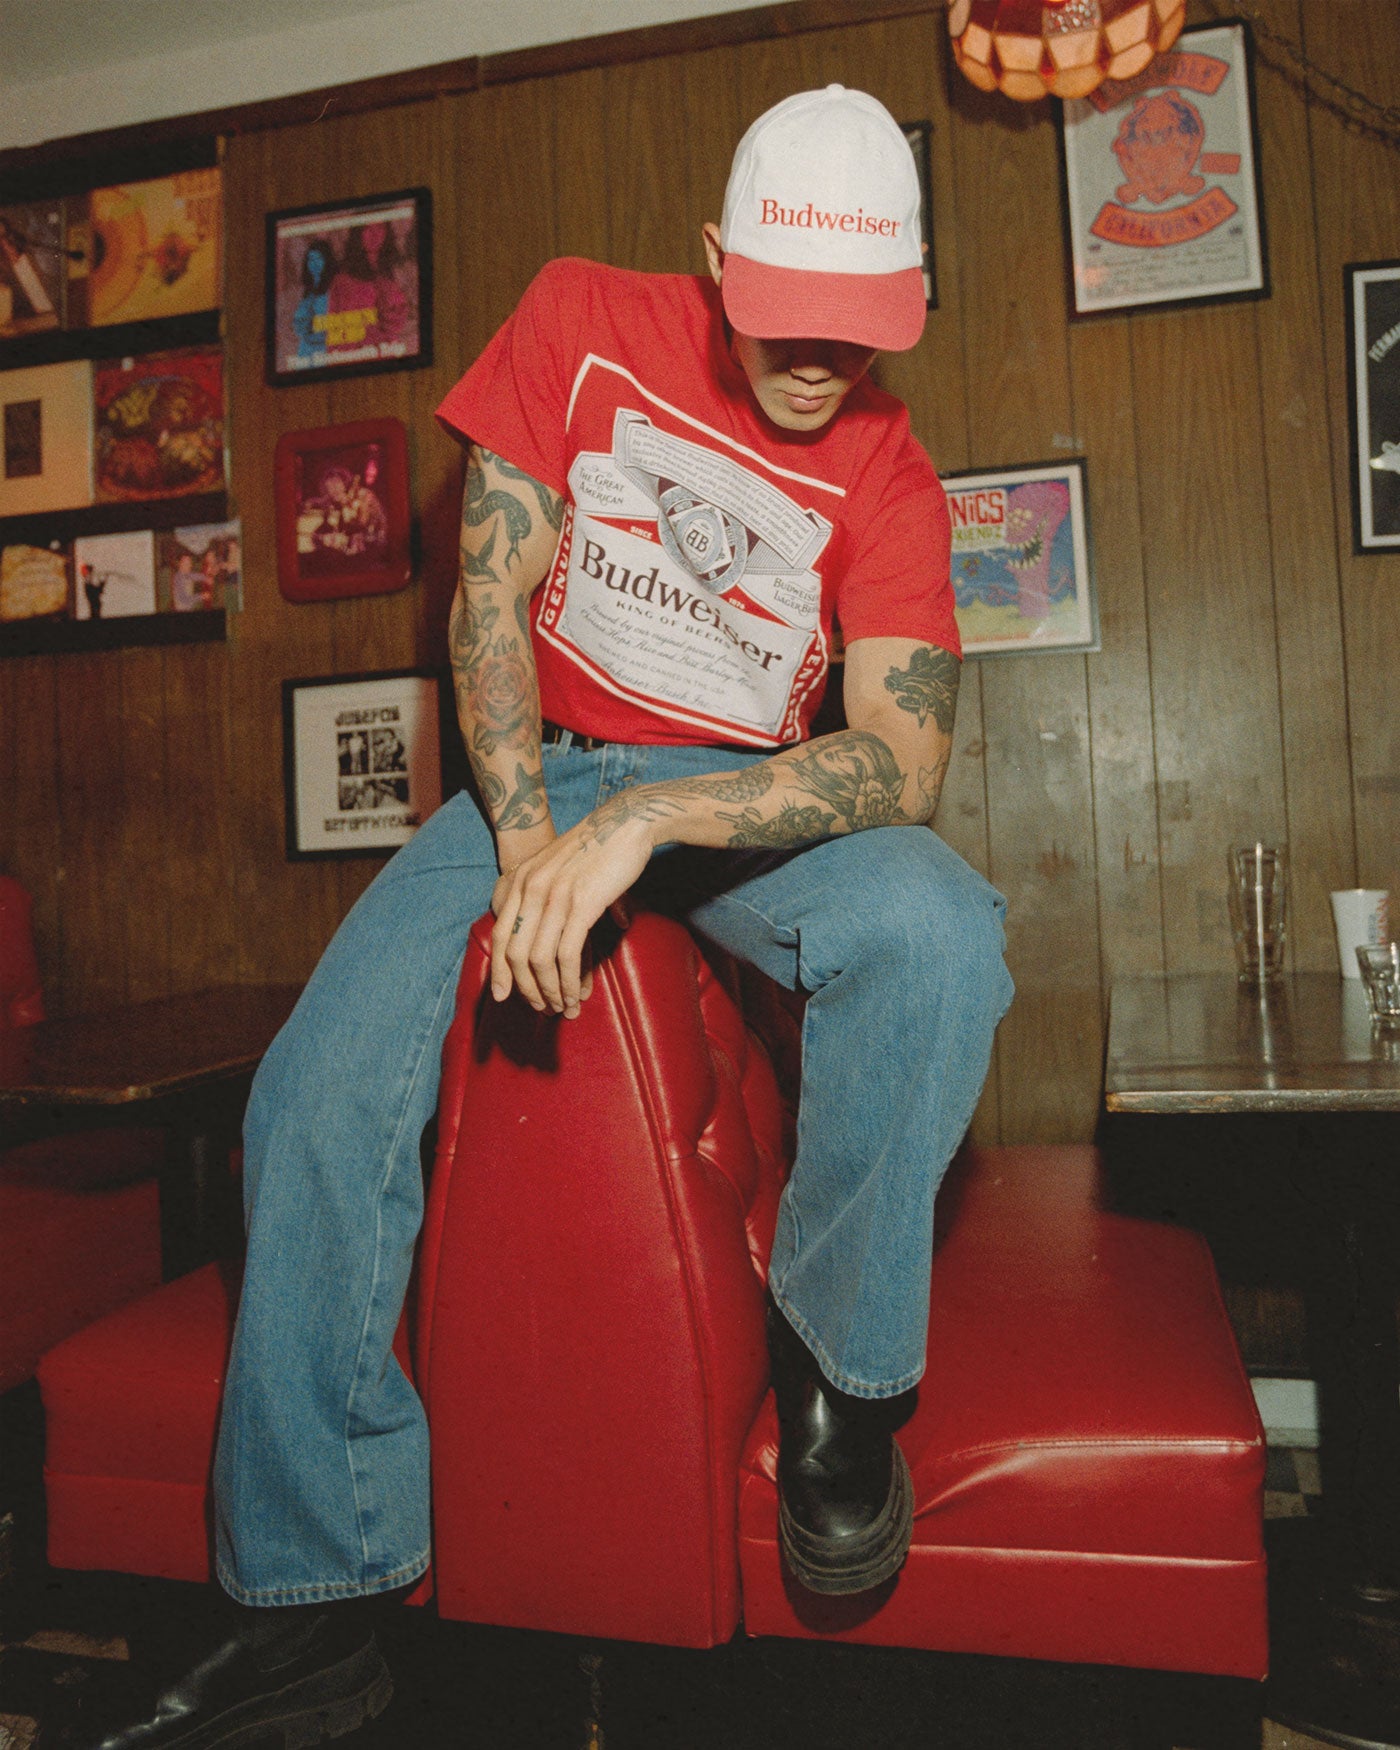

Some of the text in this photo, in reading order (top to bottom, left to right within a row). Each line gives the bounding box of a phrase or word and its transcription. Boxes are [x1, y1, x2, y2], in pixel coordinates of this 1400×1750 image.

[759, 199, 900, 238] Budweiser
[578, 467, 625, 492] THE GREAT
[578, 480, 625, 506] AMERICAN
[579, 537, 783, 672] Budweiser
[774, 591, 800, 610] LAGER
[617, 600, 732, 650] KING OF BEERS
[620, 618, 633, 633] by
[658, 650, 675, 661] and
[629, 659, 648, 669] AND
[650, 664, 682, 681] CANNED
